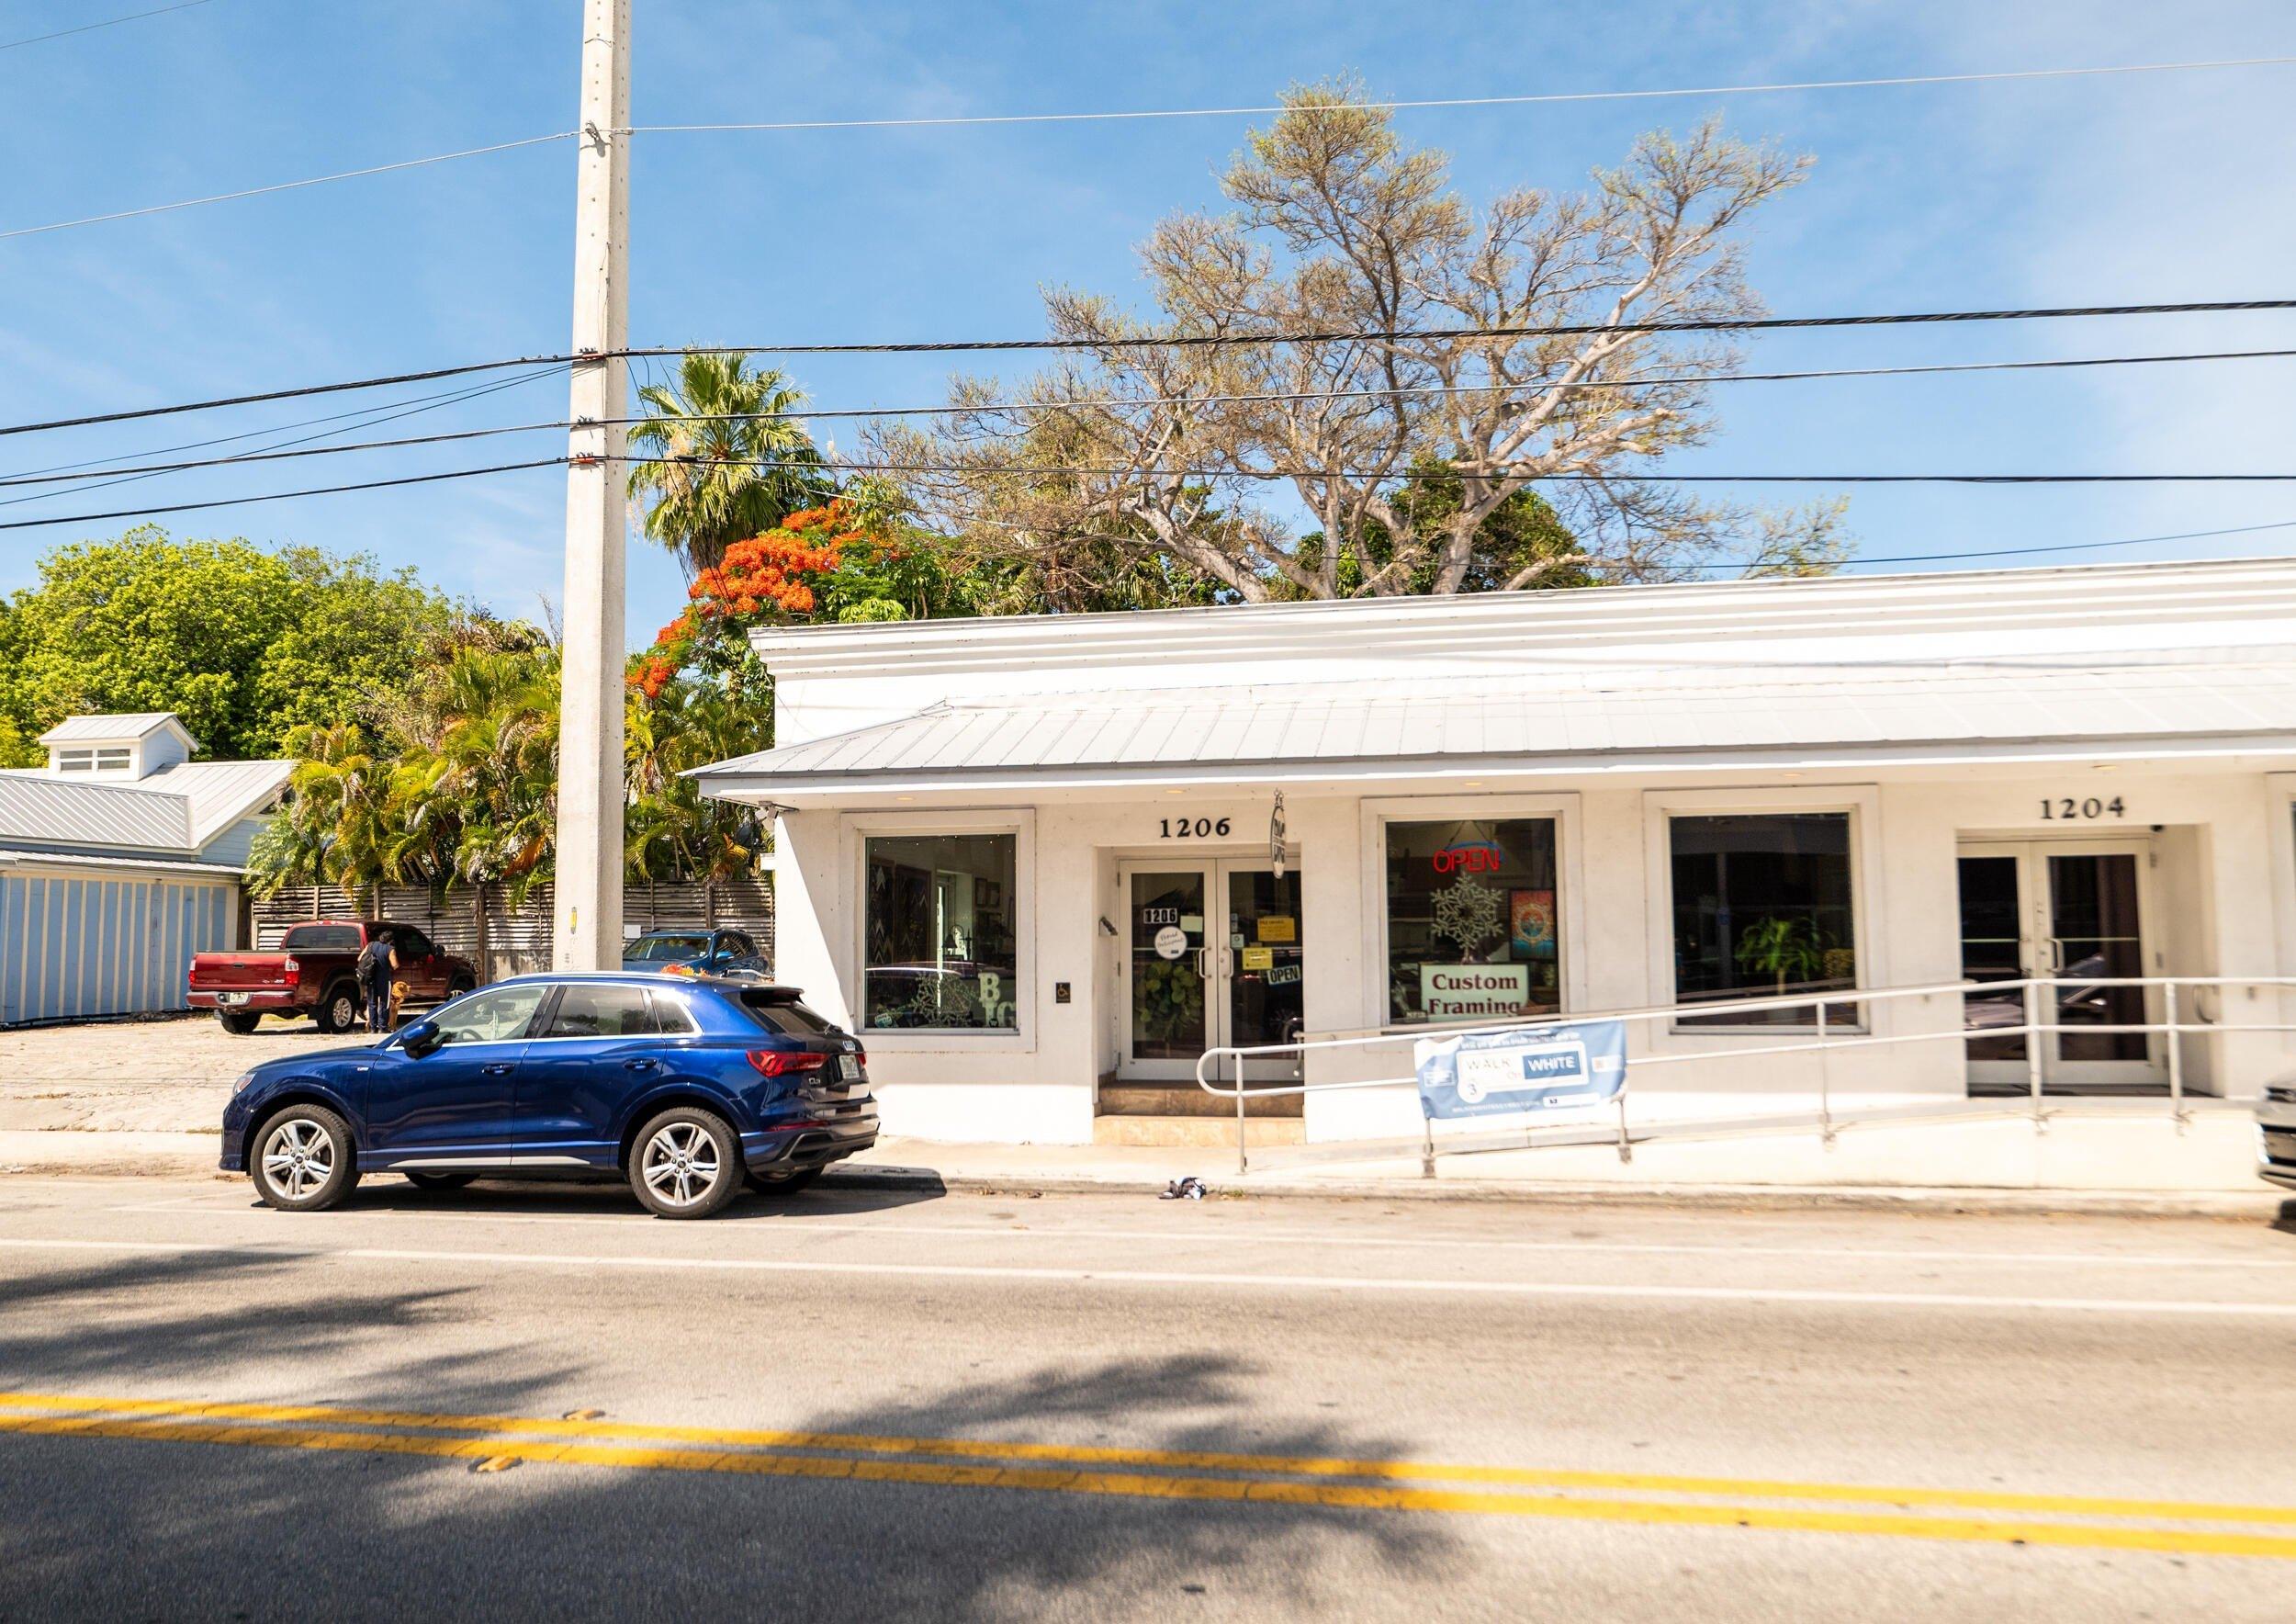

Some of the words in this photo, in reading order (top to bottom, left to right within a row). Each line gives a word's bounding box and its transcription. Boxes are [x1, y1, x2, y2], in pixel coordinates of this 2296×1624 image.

[2038, 796, 2126, 819] 1204
[1160, 818, 1231, 838] 1206
[1434, 849, 1500, 873] OPEN
[1144, 908, 1176, 923] 1206
[1269, 966, 1299, 983] OPEN
[1432, 974, 1518, 990] Custom
[1428, 998, 1521, 1017] Framing
[1527, 1055, 1576, 1072] WHITE
